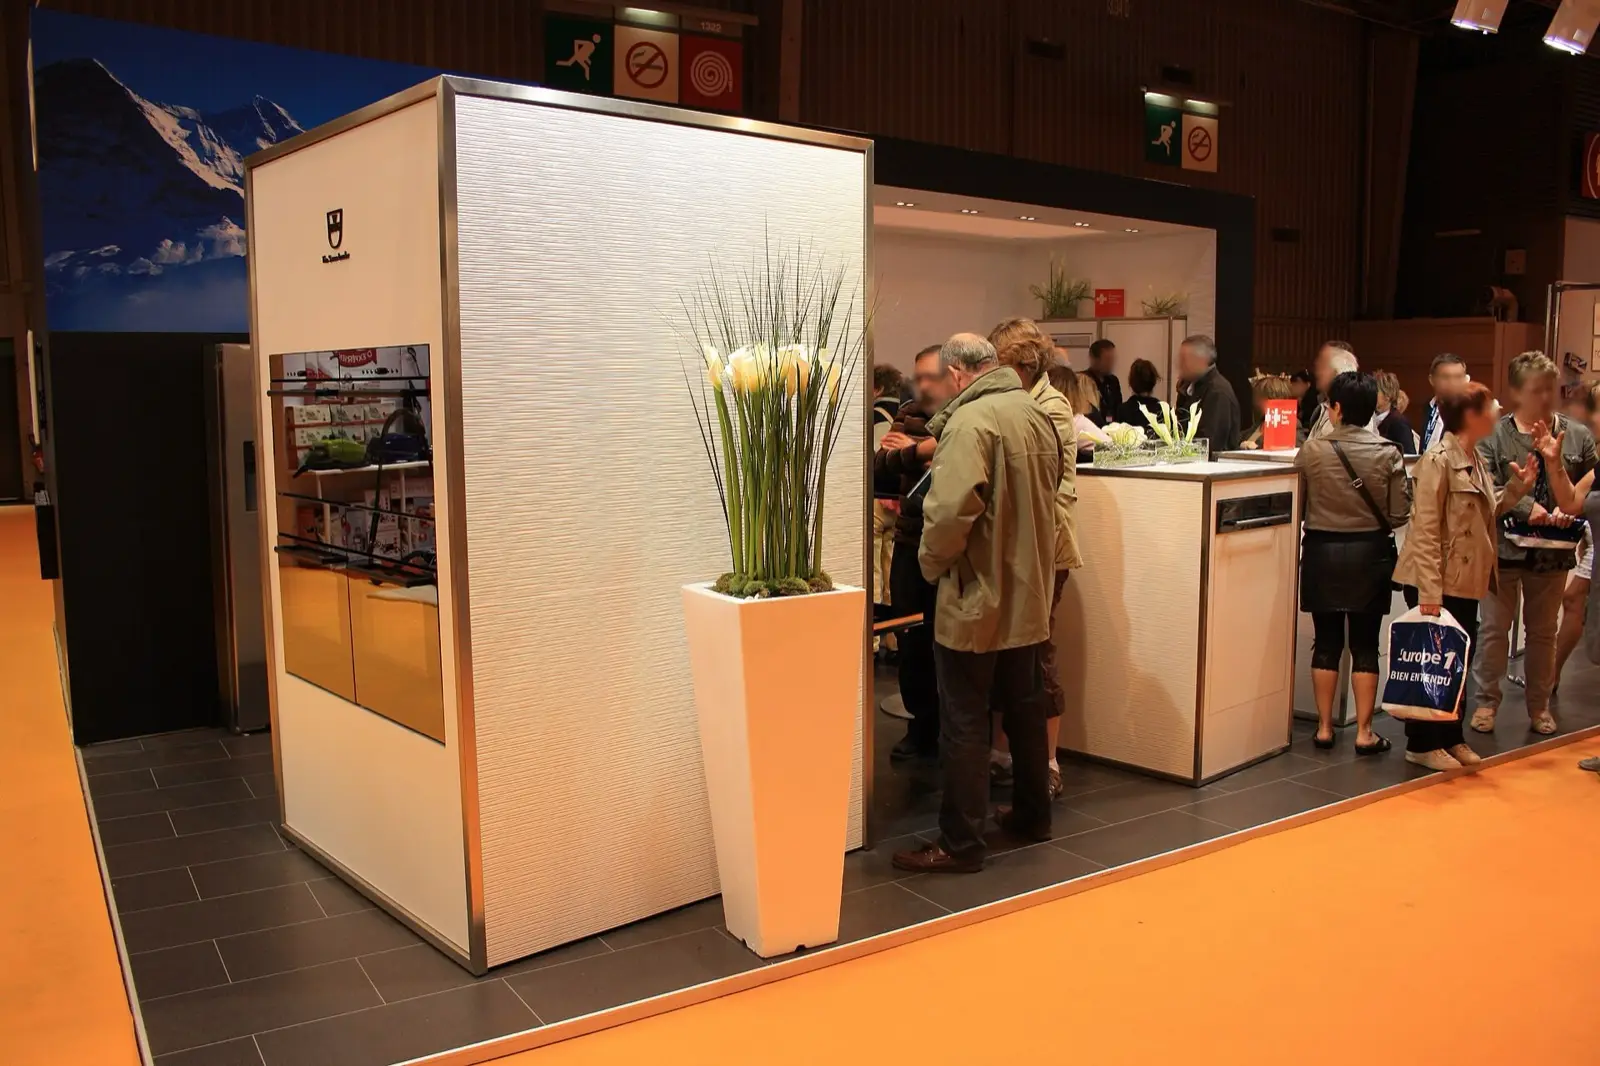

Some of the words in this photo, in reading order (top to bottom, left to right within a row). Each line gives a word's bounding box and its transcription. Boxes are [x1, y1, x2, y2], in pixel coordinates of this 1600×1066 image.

[1443, 651, 1456, 670] 1
[1390, 670, 1410, 681] BIEN
[1410, 672, 1451, 686] ENTENDU
